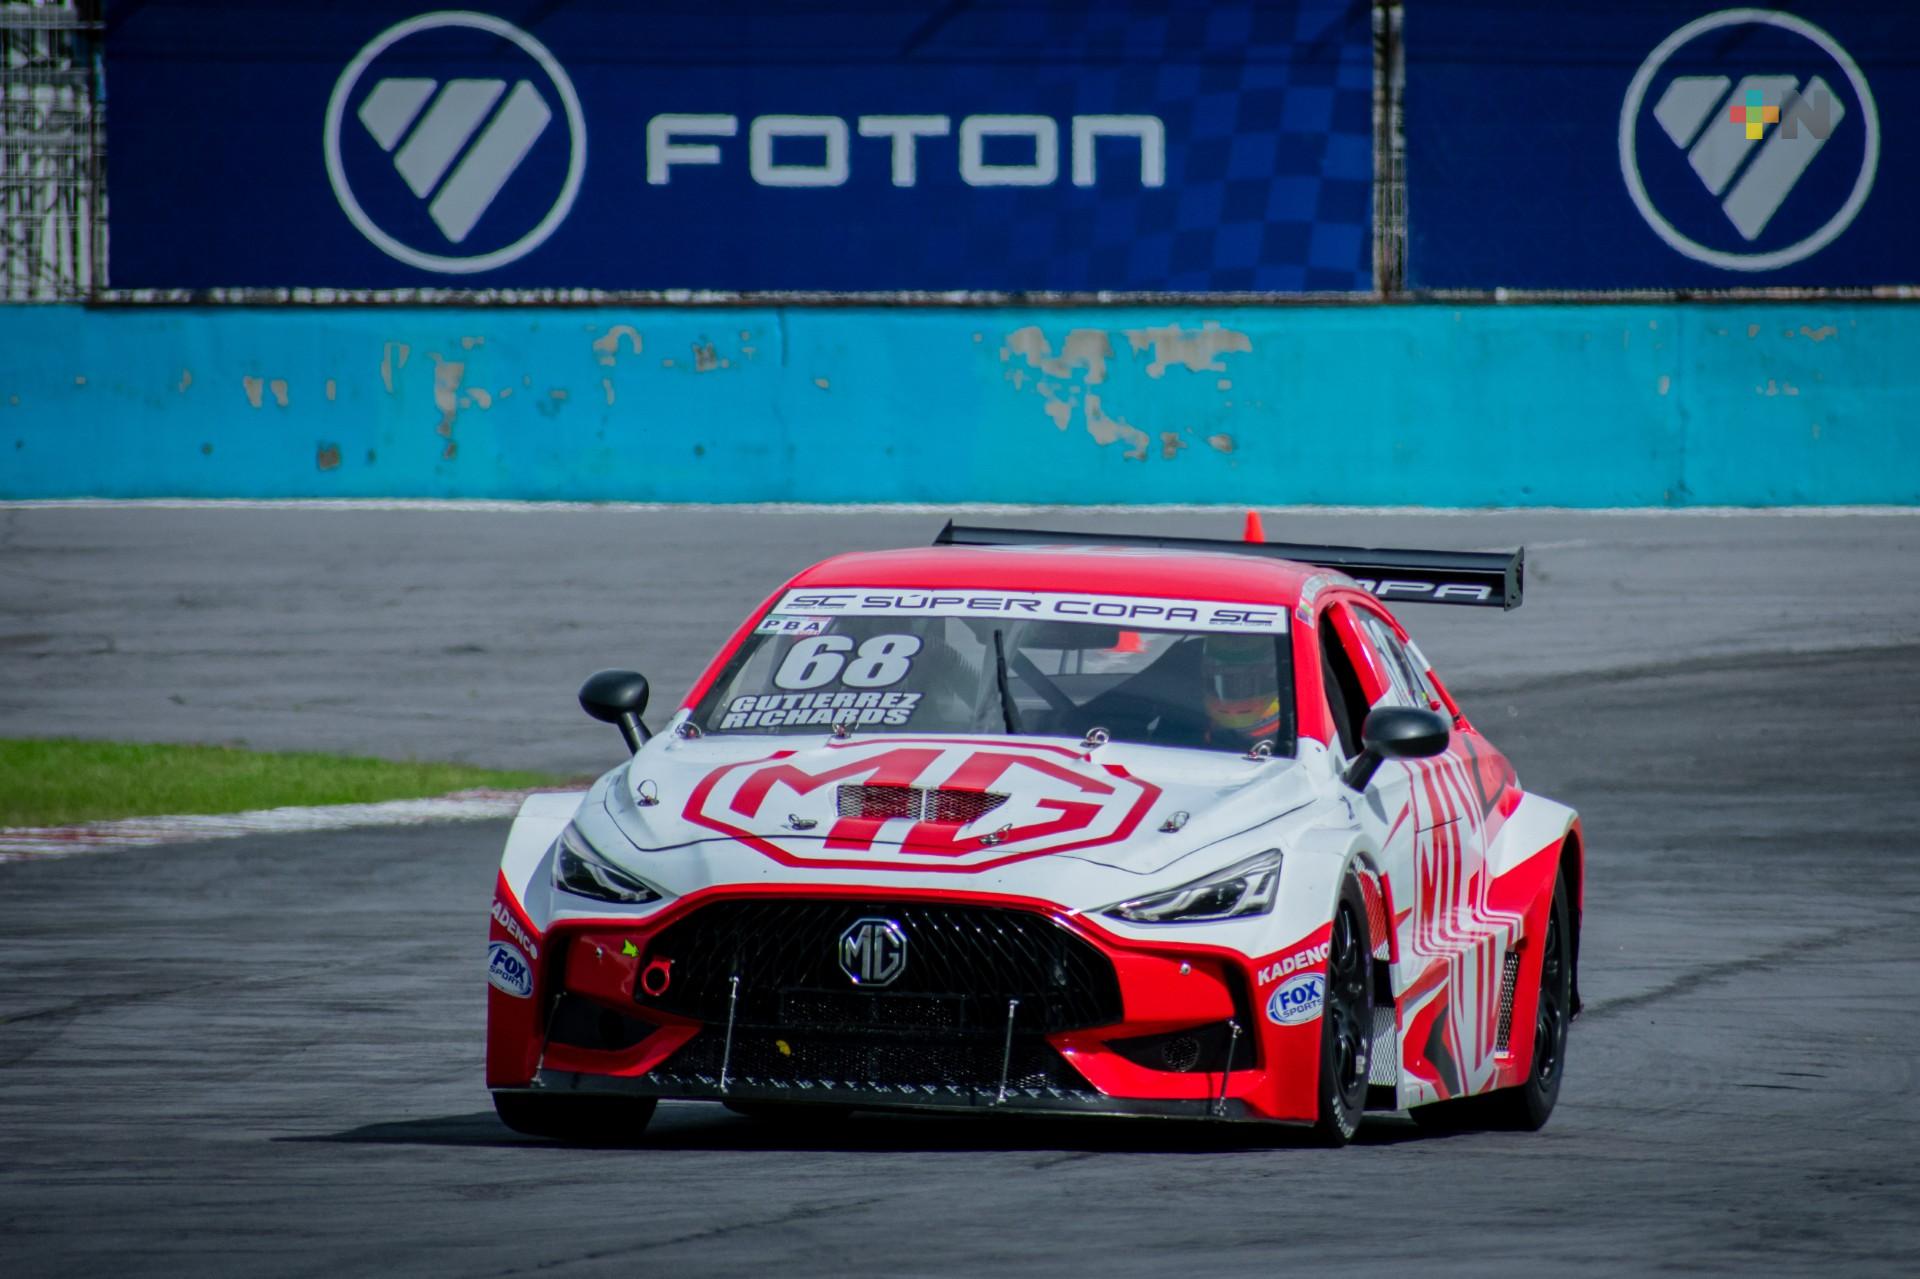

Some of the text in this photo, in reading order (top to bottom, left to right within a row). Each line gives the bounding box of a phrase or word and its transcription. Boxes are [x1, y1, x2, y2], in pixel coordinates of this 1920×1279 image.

[647, 113, 1166, 188] FOTON
[1356, 578, 1493, 600] PA
[787, 593, 1279, 624] SC SÚPER COPA SC
[774, 633, 923, 690] 68
[719, 707, 912, 730] RICHARDS
[729, 691, 923, 713] GUTIERREZ
[729, 747, 1117, 858] MG
[492, 948, 527, 984] FOX
[845, 924, 900, 980] MG
[1279, 980, 1321, 1011] FOX
